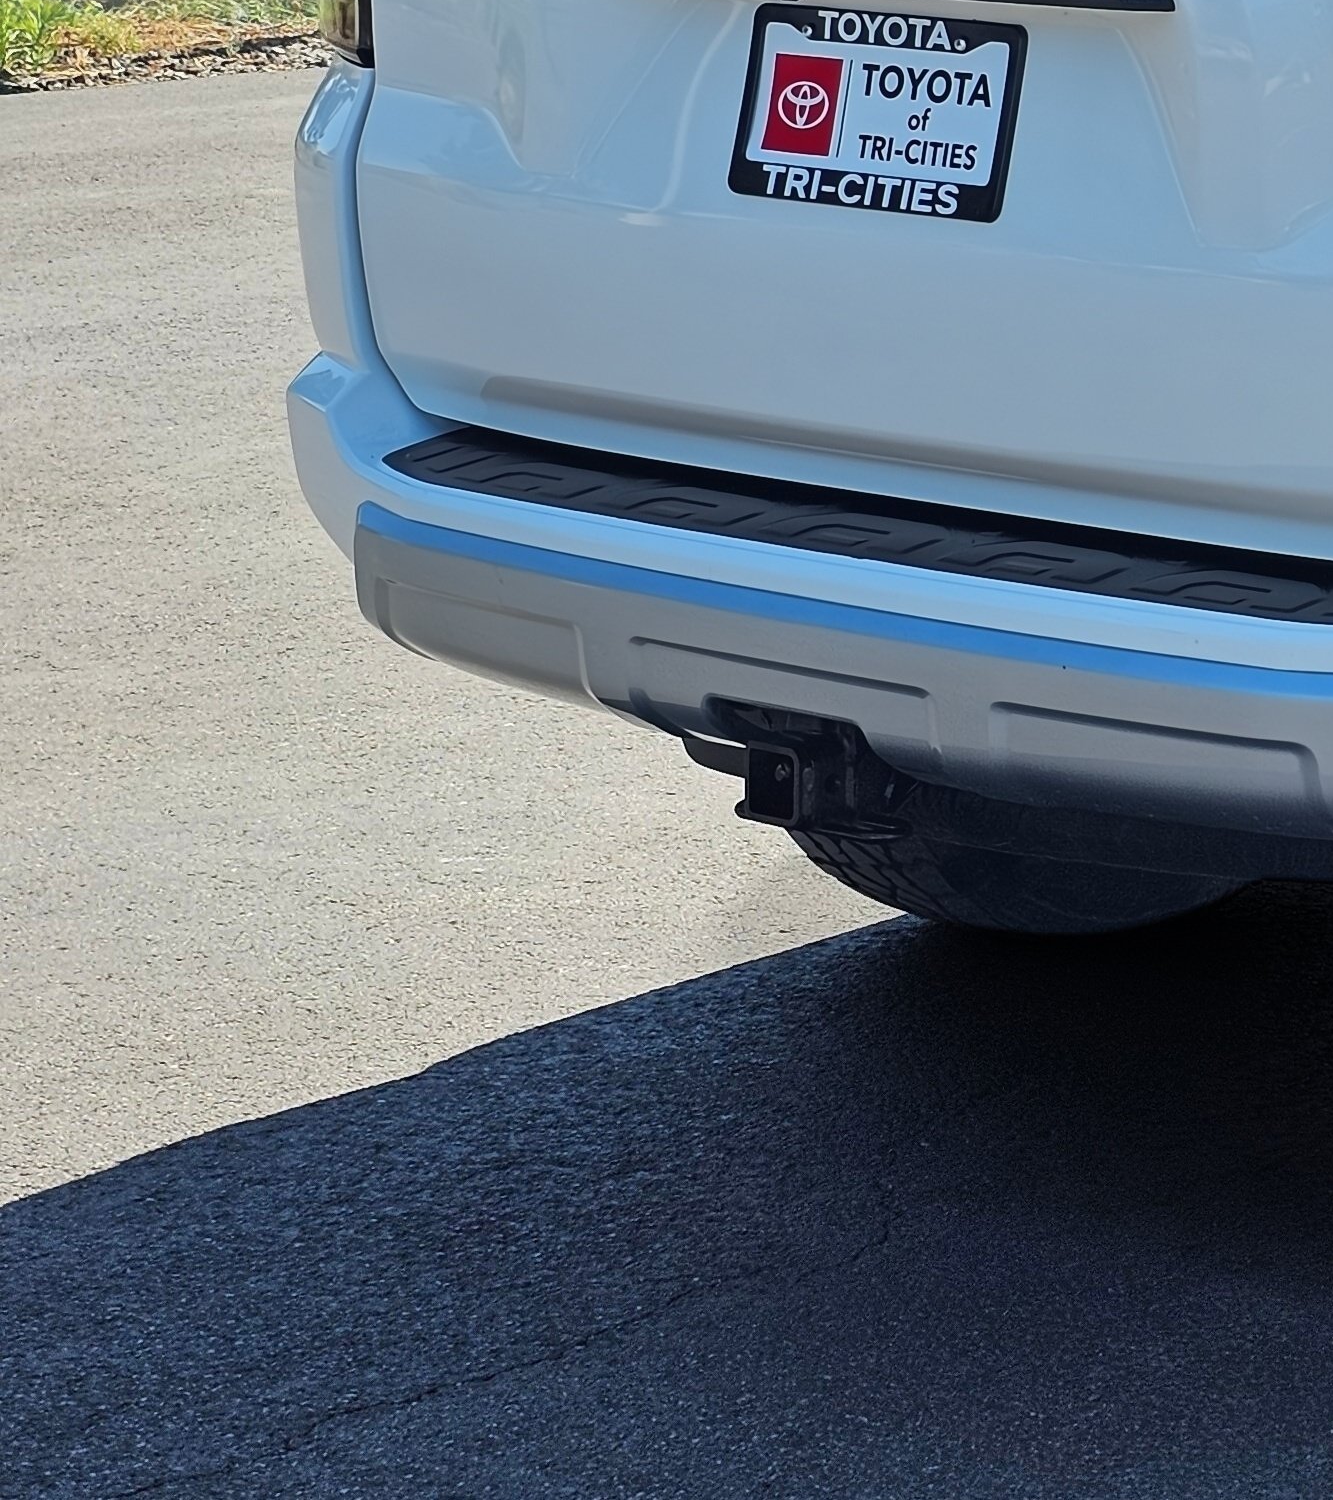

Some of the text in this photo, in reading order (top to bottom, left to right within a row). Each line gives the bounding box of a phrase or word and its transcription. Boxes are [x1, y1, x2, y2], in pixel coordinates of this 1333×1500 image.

[817, 10, 951, 50] TOYOTA
[862, 63, 992, 108] TOYOTA
[907, 108, 932, 131] of
[858, 134, 978, 171] TRI-CITIES
[762, 164, 960, 215] TRI-CITIES
